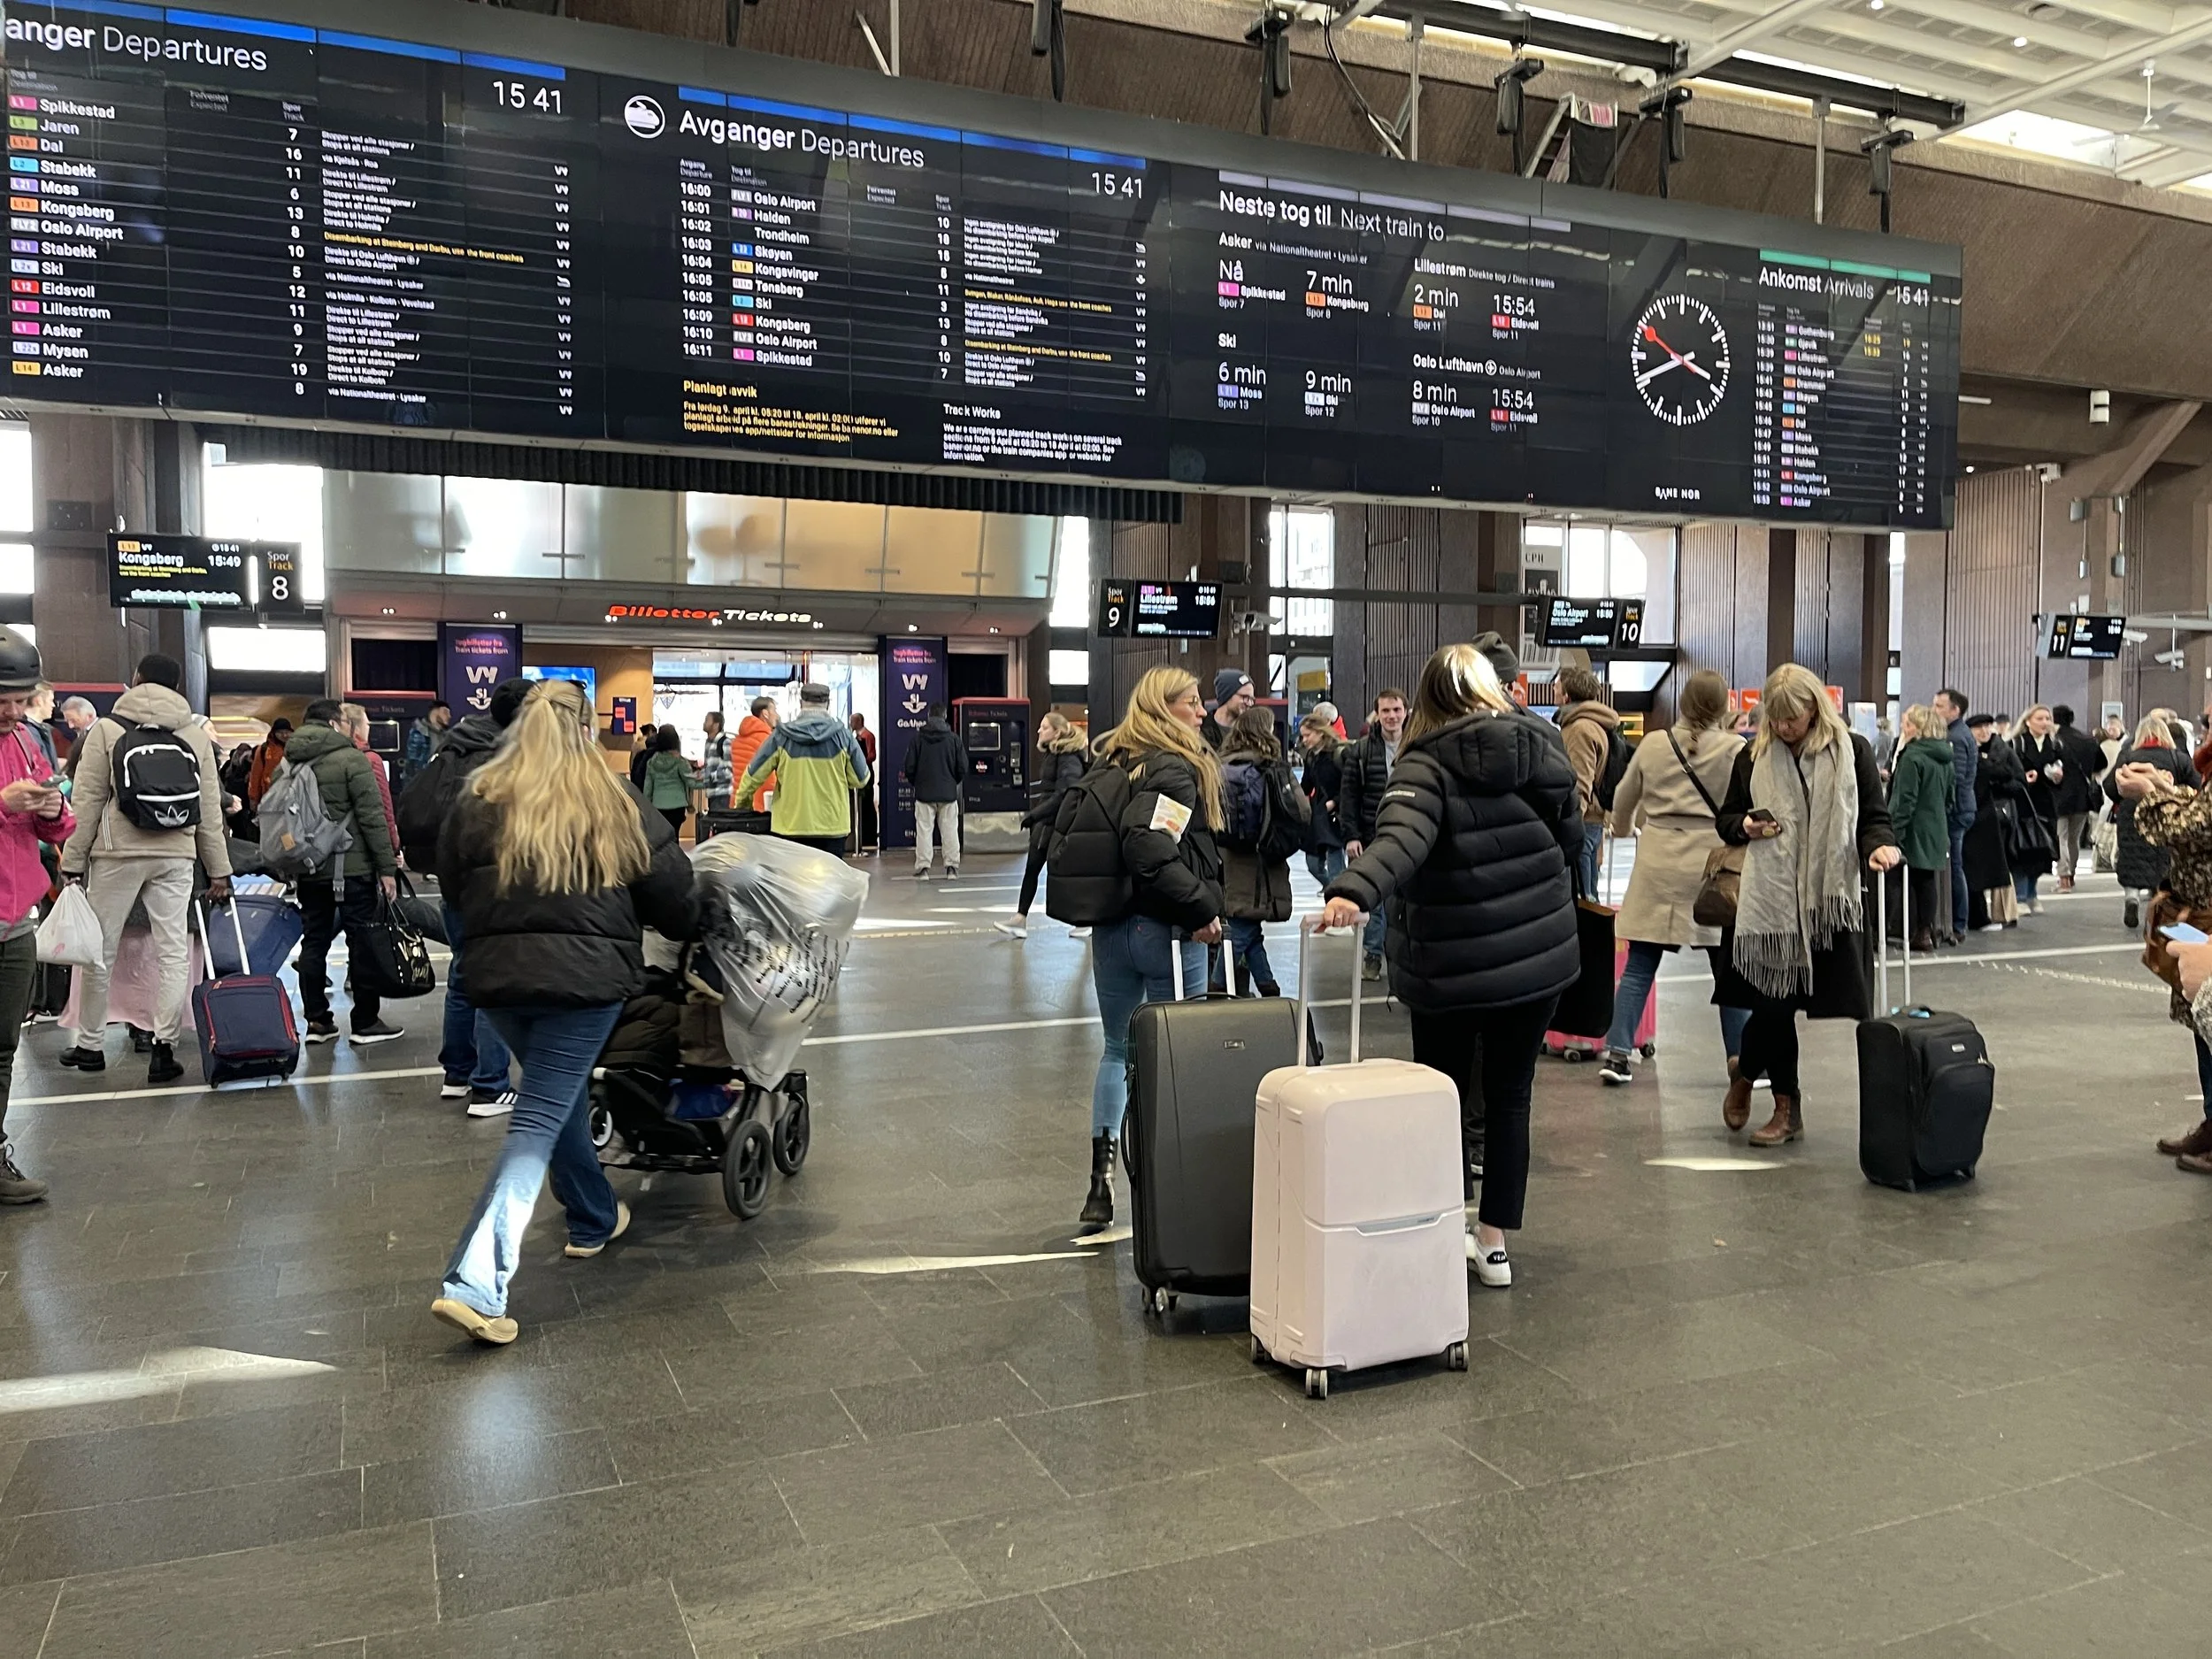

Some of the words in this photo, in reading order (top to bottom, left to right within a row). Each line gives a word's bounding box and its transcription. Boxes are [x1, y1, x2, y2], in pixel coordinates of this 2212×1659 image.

[5, 18, 95, 51] anger
[104, 26, 267, 71] Departures
[40, 98, 115, 119] Spikkestad
[288, 127, 298, 141] 7
[40, 119, 80, 134] Jaren
[285, 148, 303, 161] 16
[679, 110, 795, 151] Avganger
[802, 128, 925, 168] Departures
[40, 139, 64, 153] Dal
[286, 166, 301, 180] 11
[40, 160, 96, 178] Stabekk
[289, 188, 300, 201] 6
[41, 180, 80, 196] Moss
[287, 206, 304, 220] 13
[41, 199, 115, 221] Kongsberg
[680, 182, 711, 197] 16:00
[754, 191, 778, 206] Oslo
[780, 196, 816, 211] Airport
[938, 217, 950, 229] 10
[1219, 190, 1276, 218] Neste
[1279, 200, 1310, 227] tog
[1315, 204, 1331, 227] til
[681, 200, 710, 215] 16:01
[754, 209, 791, 226] Halden
[681, 218, 711, 233] 16:02
[755, 227, 810, 245] Trondheim
[1340, 207, 1381, 234] Next
[1386, 214, 1423, 239] train
[1427, 221, 1445, 242] to
[41, 220, 73, 236] Oslo
[75, 223, 124, 241] Airport
[288, 244, 305, 257] 10
[681, 236, 712, 251] 16:03
[755, 245, 793, 262] Skøyen
[1218, 232, 1253, 250] Asker
[1255, 240, 1267, 251] via
[1269, 242, 1332, 261] Nationaltheatret
[42, 242, 96, 258] Stabekk
[292, 265, 302, 279] 5
[1219, 259, 1244, 282] Nå
[42, 262, 64, 276] Ski
[288, 285, 306, 299] 12
[682, 254, 712, 269] 16:04
[755, 263, 819, 281] Kongsvinger
[938, 284, 949, 296] 11
[1306, 270, 1317, 290] 7
[1322, 273, 1353, 295] min
[1415, 258, 1465, 277] Lillestrøm
[1469, 268, 1494, 280] Direkte
[1495, 271, 1506, 283] tog
[1536, 277, 1555, 288] trains
[1759, 266, 1821, 293] Ankomst
[1824, 277, 1873, 300] Arrivals
[42, 281, 96, 298] Eidsvoll
[289, 304, 305, 318] 11
[756, 280, 804, 298] Tønsberg
[1240, 285, 1286, 301] Spikkestad
[1415, 284, 1424, 303] 2
[1428, 288, 1458, 307] min
[756, 297, 772, 310] Ski
[1218, 296, 1238, 309] Spor
[1240, 299, 1245, 309] 7
[1306, 307, 1325, 319] Spor
[1327, 296, 1370, 312] Kongsberg
[1494, 295, 1535, 317] 15:54
[42, 303, 111, 319] Lillestrøm
[293, 324, 303, 337] 9
[682, 308, 713, 322] 16:09
[756, 315, 810, 334] Kongsberg
[1414, 319, 1430, 331] Spor
[1433, 309, 1446, 319] Dal
[1511, 318, 1539, 330] Eidsvoll
[42, 324, 83, 338] Asker
[294, 344, 303, 357] 7
[683, 326, 713, 340] 16:10
[756, 333, 780, 346] Oslo
[781, 335, 818, 350] Airport
[938, 351, 951, 363] 10
[1218, 333, 1236, 349] Ski
[1493, 328, 1509, 340] Spor
[42, 343, 88, 359] Mysen
[291, 363, 308, 376] 19
[683, 342, 712, 357] 16:11
[756, 350, 812, 367] Spikkestad
[941, 368, 948, 379] 7
[1413, 354, 1436, 369] Oslo
[1440, 357, 1483, 373] Lufthavn
[42, 364, 83, 378] Asker
[295, 381, 304, 395] 8
[1218, 362, 1230, 382] 6
[1234, 365, 1266, 385] min
[1305, 370, 1317, 389] 9
[1321, 373, 1351, 393] min
[1500, 365, 1515, 376] Oslo
[1517, 367, 1540, 379] Airport
[683, 380, 726, 397] Planlagt
[729, 387, 758, 398] avvik
[1240, 386, 1263, 399] Moss
[1325, 394, 1338, 406] Ski
[1413, 380, 1423, 400] 8
[1428, 383, 1456, 403] min
[1493, 388, 1533, 410] 15:54
[943, 403, 971, 417] Track
[972, 406, 1001, 419] Works
[1218, 398, 1237, 410] Spor
[1305, 405, 1323, 417] Spor
[1432, 403, 1448, 416] Oslo
[1450, 405, 1475, 419] Airport
[1413, 415, 1429, 426] Spor
[1510, 411, 1538, 424] Eidsvoll
[1655, 487, 1678, 500] BANE
[1681, 488, 1700, 500] NOR
[119, 552, 183, 567] Kongsberg
[207, 555, 241, 567] 15:49
[267, 551, 289, 561] Spor
[268, 561, 293, 571] Track
[272, 576, 288, 600] 8
[1108, 595, 1124, 603] Track
[609, 606, 720, 619] Billetter
[723, 609, 811, 623] Tickets
[1109, 607, 1120, 627] 9
[1552, 608, 1566, 618] Oslo
[1567, 608, 1589, 619] Airport
[1622, 623, 1639, 641] 10
[2053, 634, 2065, 652] 11
[476, 688, 488, 699] SJ
[910, 694, 919, 703] SJ
